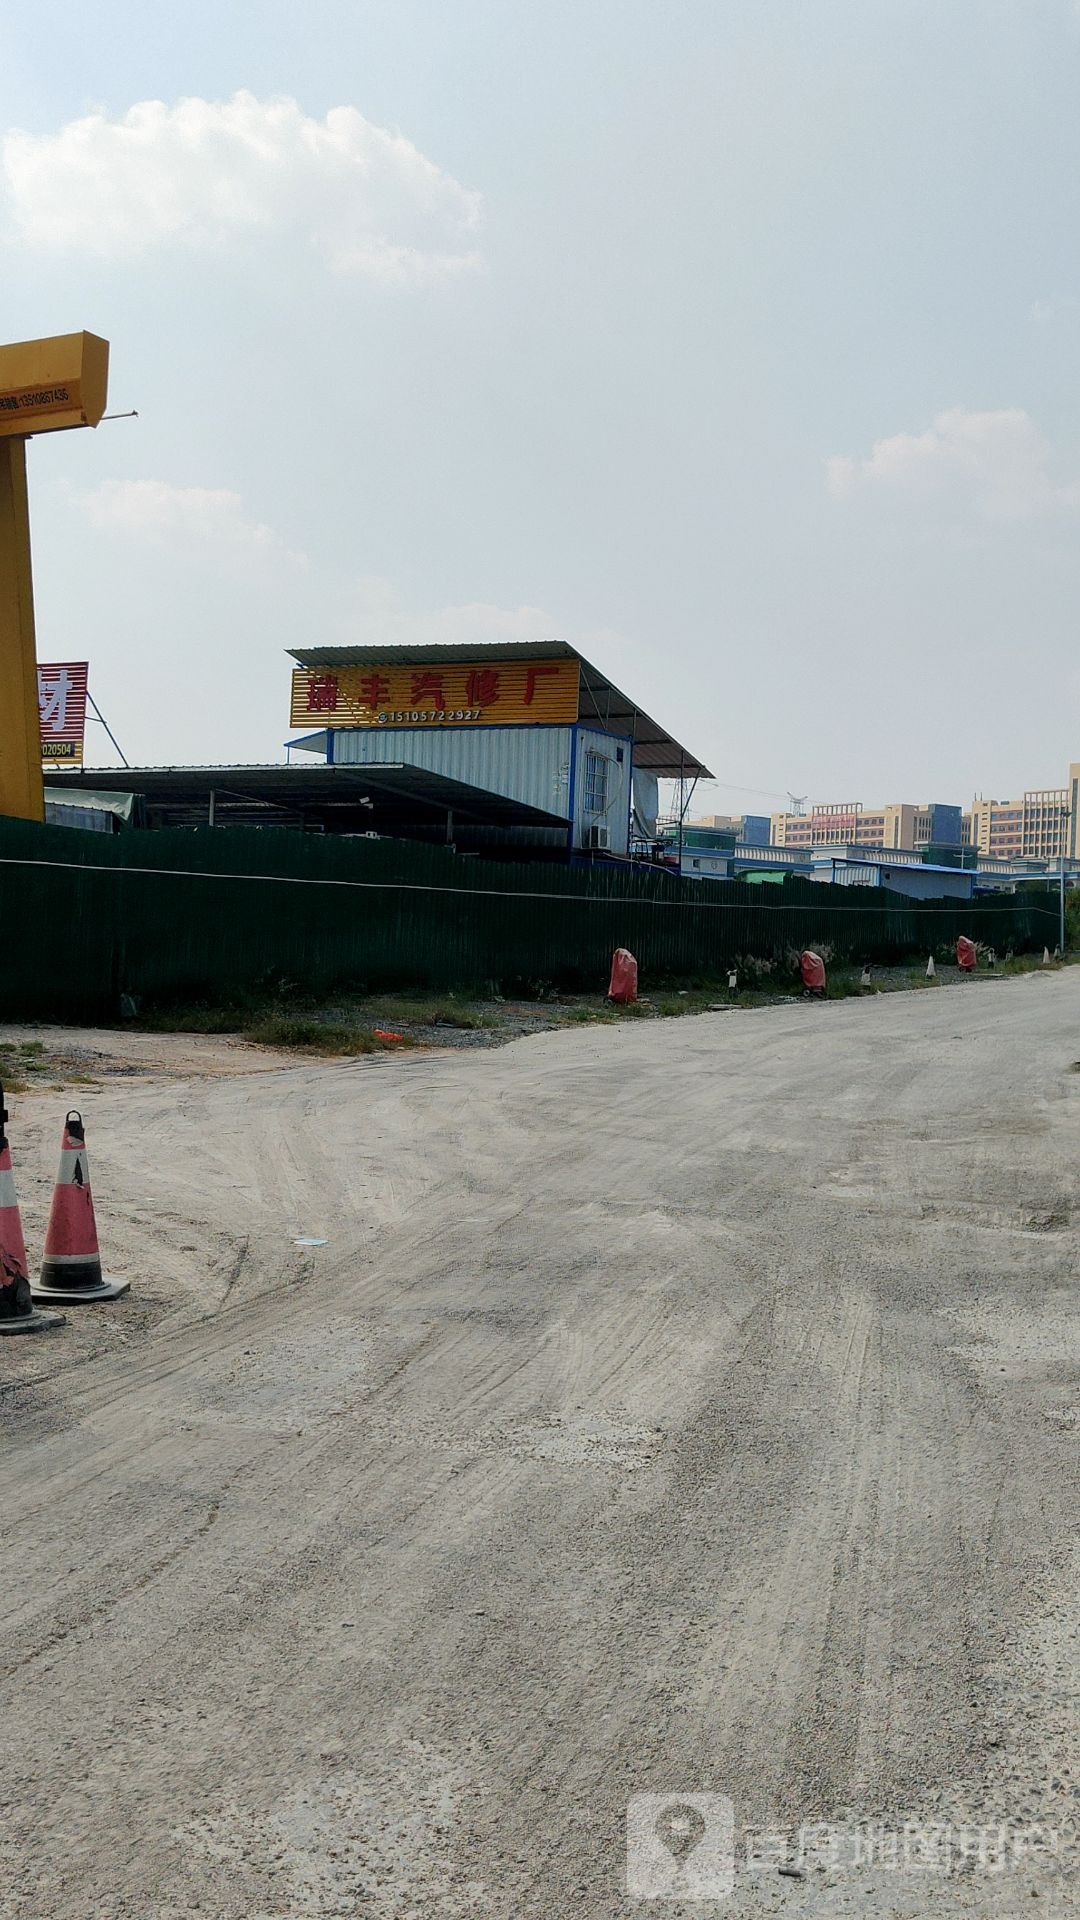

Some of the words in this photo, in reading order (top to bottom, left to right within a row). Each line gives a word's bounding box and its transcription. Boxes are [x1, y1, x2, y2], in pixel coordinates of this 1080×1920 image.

[307, 666, 560, 712] 瑞丰汽修厂
[389, 710, 482, 723] 15105722927
